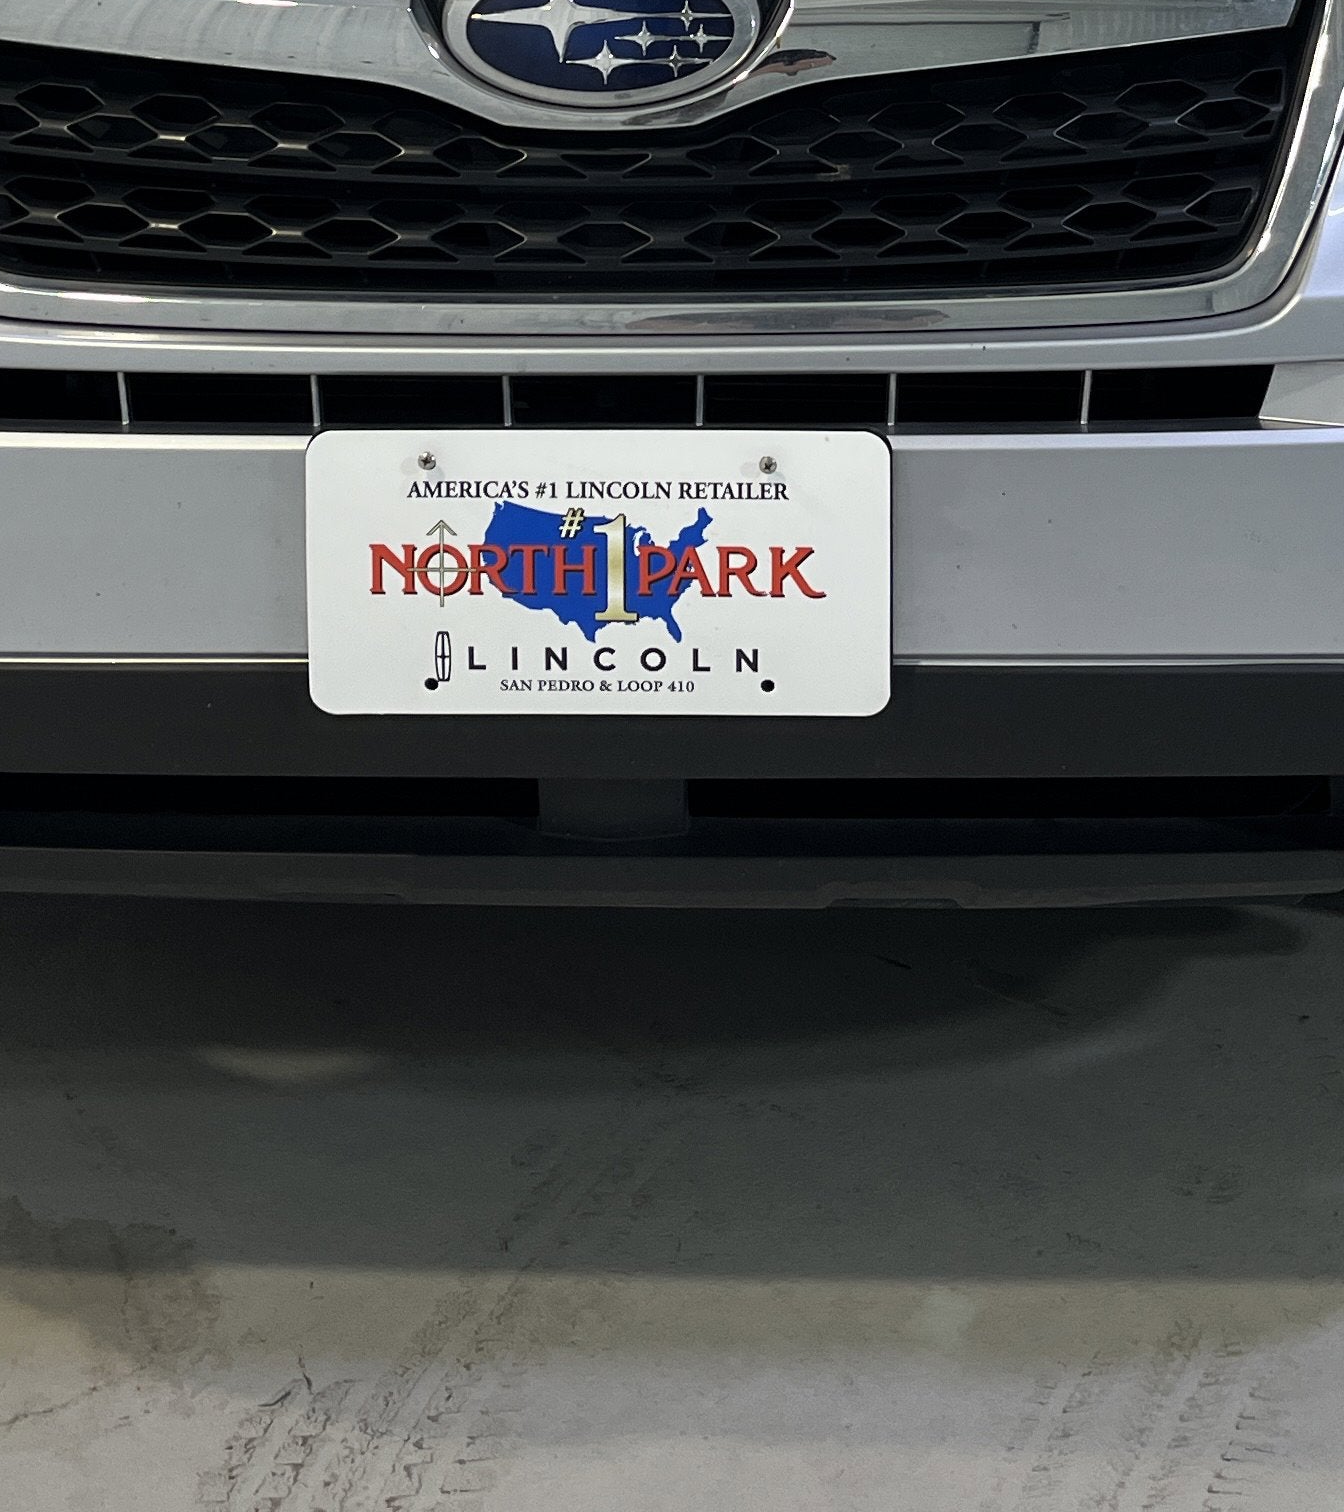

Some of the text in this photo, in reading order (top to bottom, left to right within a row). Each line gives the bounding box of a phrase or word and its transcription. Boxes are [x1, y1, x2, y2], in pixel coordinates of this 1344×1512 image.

[406, 480, 790, 502] AMERICA'S #1 LINCOLN RETAILER
[369, 543, 828, 599] NORTH PARK
[467, 645, 759, 673] LINCOLN
[499, 678, 695, 693] SAN PEDRO & LOOP 410
